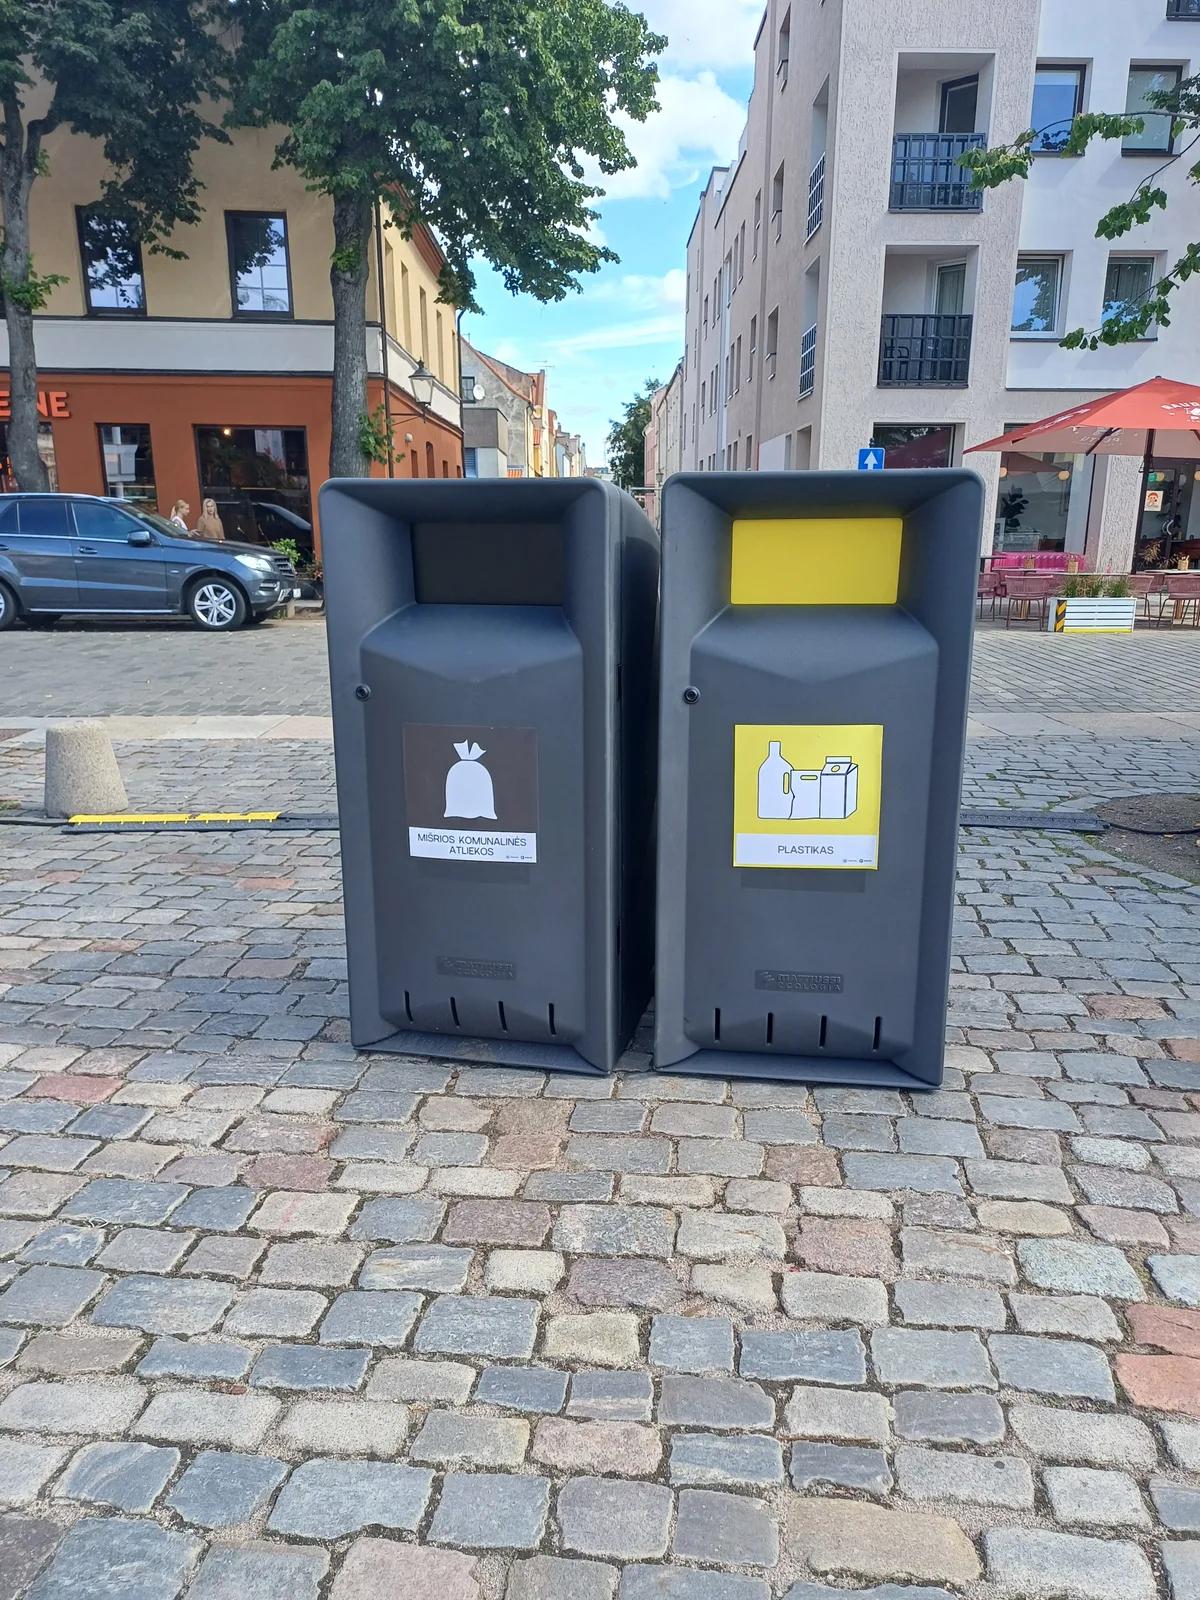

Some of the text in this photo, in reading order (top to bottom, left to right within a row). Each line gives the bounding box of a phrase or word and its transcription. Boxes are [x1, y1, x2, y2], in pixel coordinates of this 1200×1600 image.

[417, 833, 527, 847] MIŠRIOS KOMUNALINĖS
[449, 846, 494, 856] ATLIEKOS
[777, 845, 834, 855] PLASTIKAS
